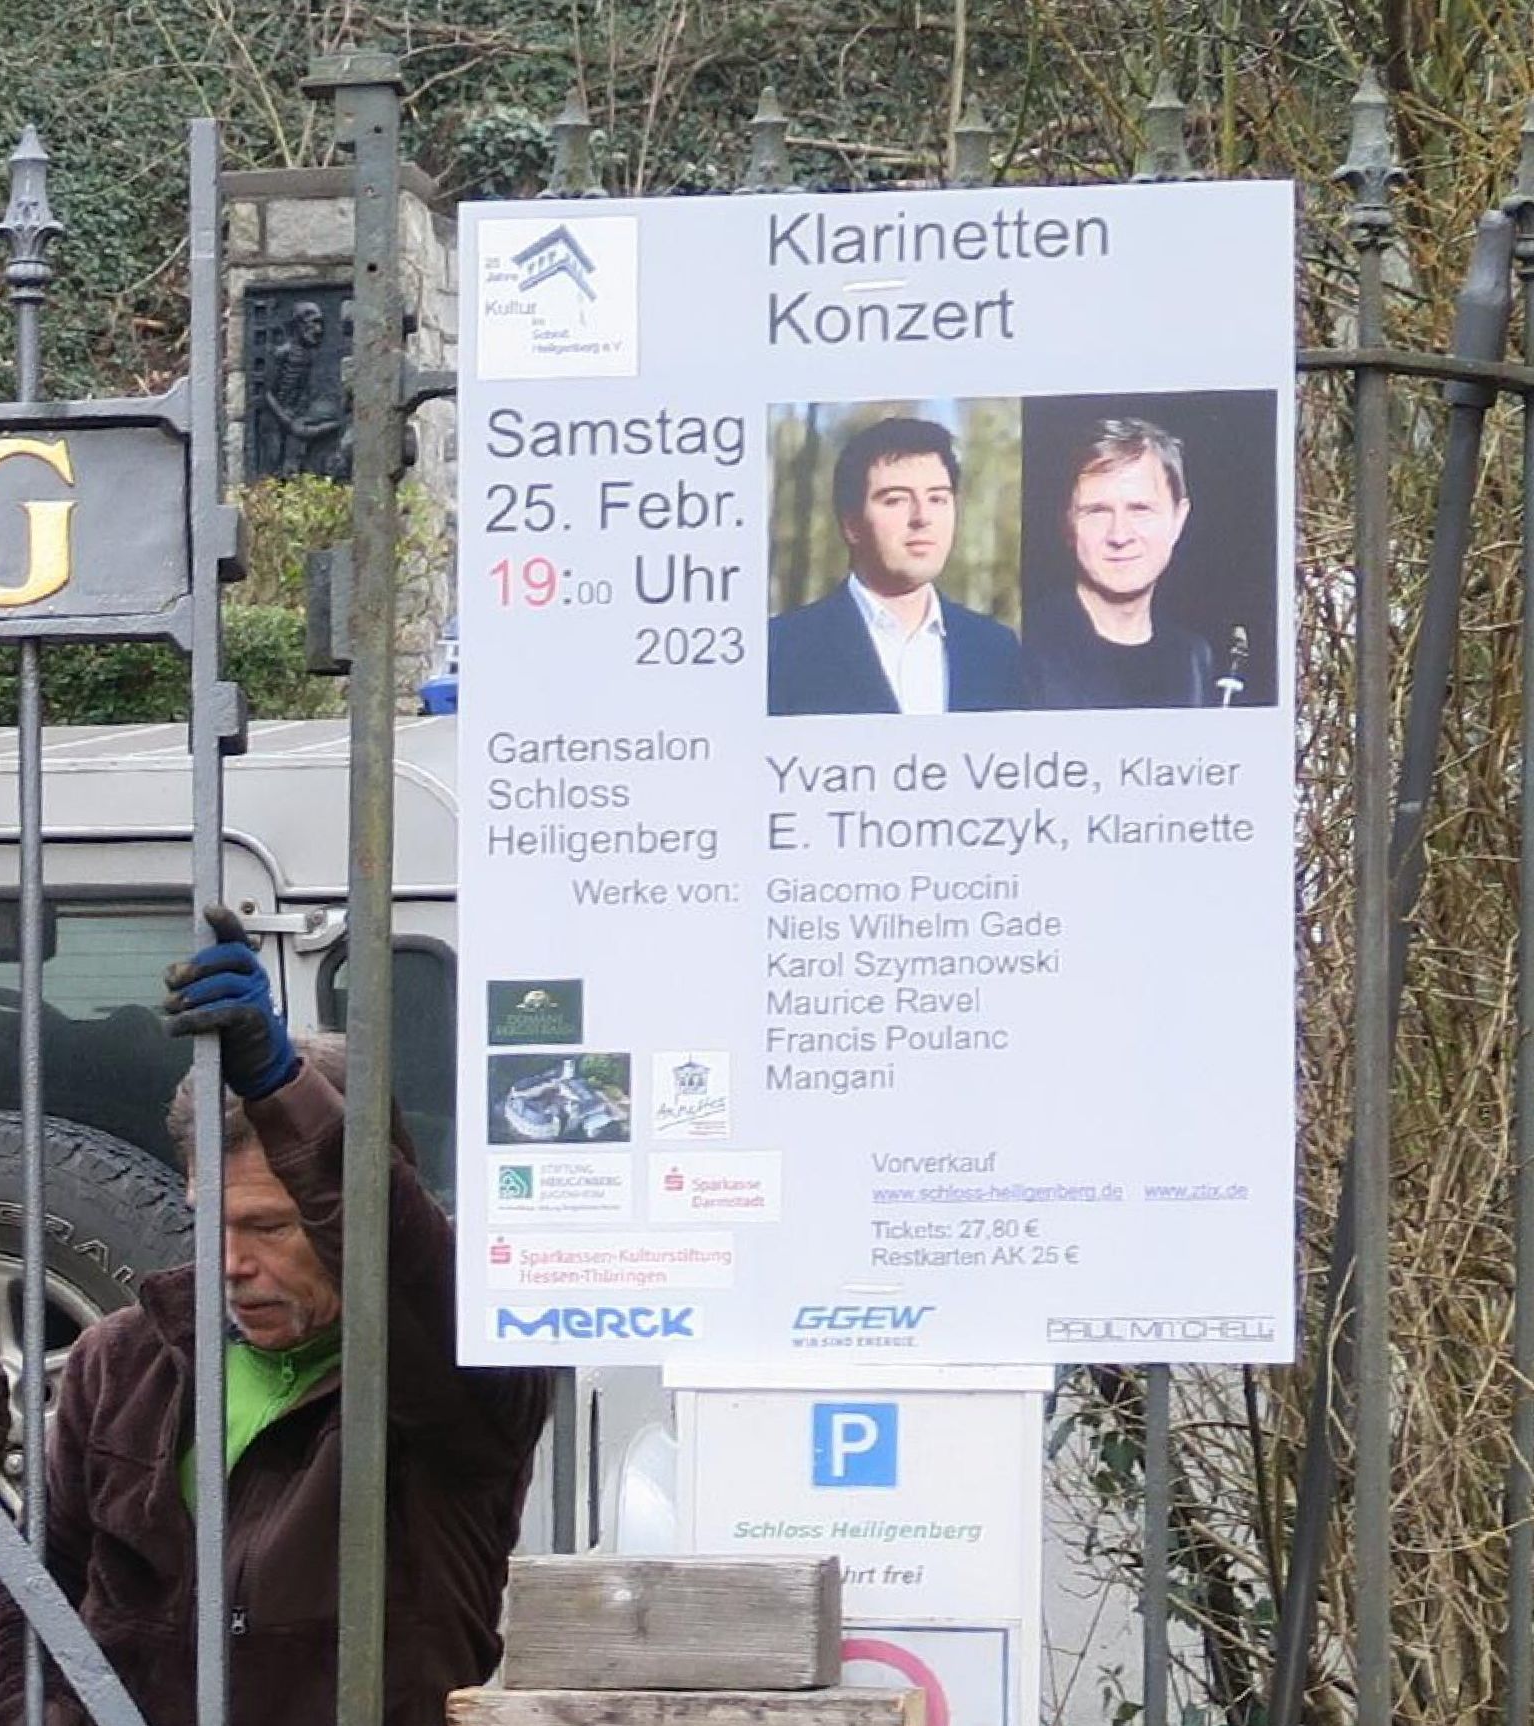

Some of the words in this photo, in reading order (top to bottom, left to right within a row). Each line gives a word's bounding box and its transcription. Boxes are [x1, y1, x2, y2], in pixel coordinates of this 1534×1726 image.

[768, 208, 1110, 266] Klarinetten
[484, 299, 538, 316] Kultur
[768, 288, 1015, 345] Konzert
[486, 407, 746, 467] Samstag
[485, 483, 572, 533] 25.
[600, 478, 744, 531] Febr.
[489, 556, 613, 607] 19:00
[634, 553, 741, 605] Uhr
[635, 626, 745, 666] 2023
[487, 730, 711, 764] Gartensalon
[764, 755, 876, 794] Yvan
[893, 753, 948, 793] de
[962, 750, 1102, 795] Velde,
[1119, 756, 1241, 788] Klavier
[487, 777, 631, 811] Schloss
[487, 821, 718, 863] Heiligenberg
[768, 811, 810, 850] E.
[826, 807, 1070, 856] Thomczyk,
[1086, 811, 1255, 844] Klarinette
[571, 878, 669, 906] Werke
[676, 882, 740, 904] von:
[765, 877, 901, 903] Giacomo
[910, 874, 1020, 902] Puccini
[766, 914, 841, 941] Niels
[849, 912, 970, 940] Wilhelm
[979, 910, 1063, 938] Gade
[766, 951, 844, 978] Karol
[854, 949, 1060, 983] Szymanowski
[766, 988, 886, 1016] Maurice
[896, 986, 981, 1014] Ravel
[765, 1026, 877, 1053] Francis
[885, 1024, 1010, 1052] Poulanc
[765, 1062, 895, 1095] Mangani
[871, 1151, 998, 1174] Vorverkauf
[691, 1176, 762, 1194] Sparkasse
[691, 1194, 766, 1208] Darmstadt
[871, 1219, 953, 1240] Tickets:
[1023, 1218, 1040, 1239] €
[519, 1248, 733, 1268] Sparkassen-Kulturstiftung
[871, 1247, 986, 1267] Restkarten
[991, 1246, 1024, 1266] AK
[1031, 1246, 1059, 1265] 25
[1063, 1245, 1080, 1265] €
[519, 1268, 668, 1286] Hessen-Thüringen
[792, 1305, 937, 1330] GGEW
[831, 1412, 880, 1478] P
[732, 1519, 824, 1540] Schloss
[830, 1518, 984, 1544] Heiligenberg
[881, 1563, 925, 1586] frei
